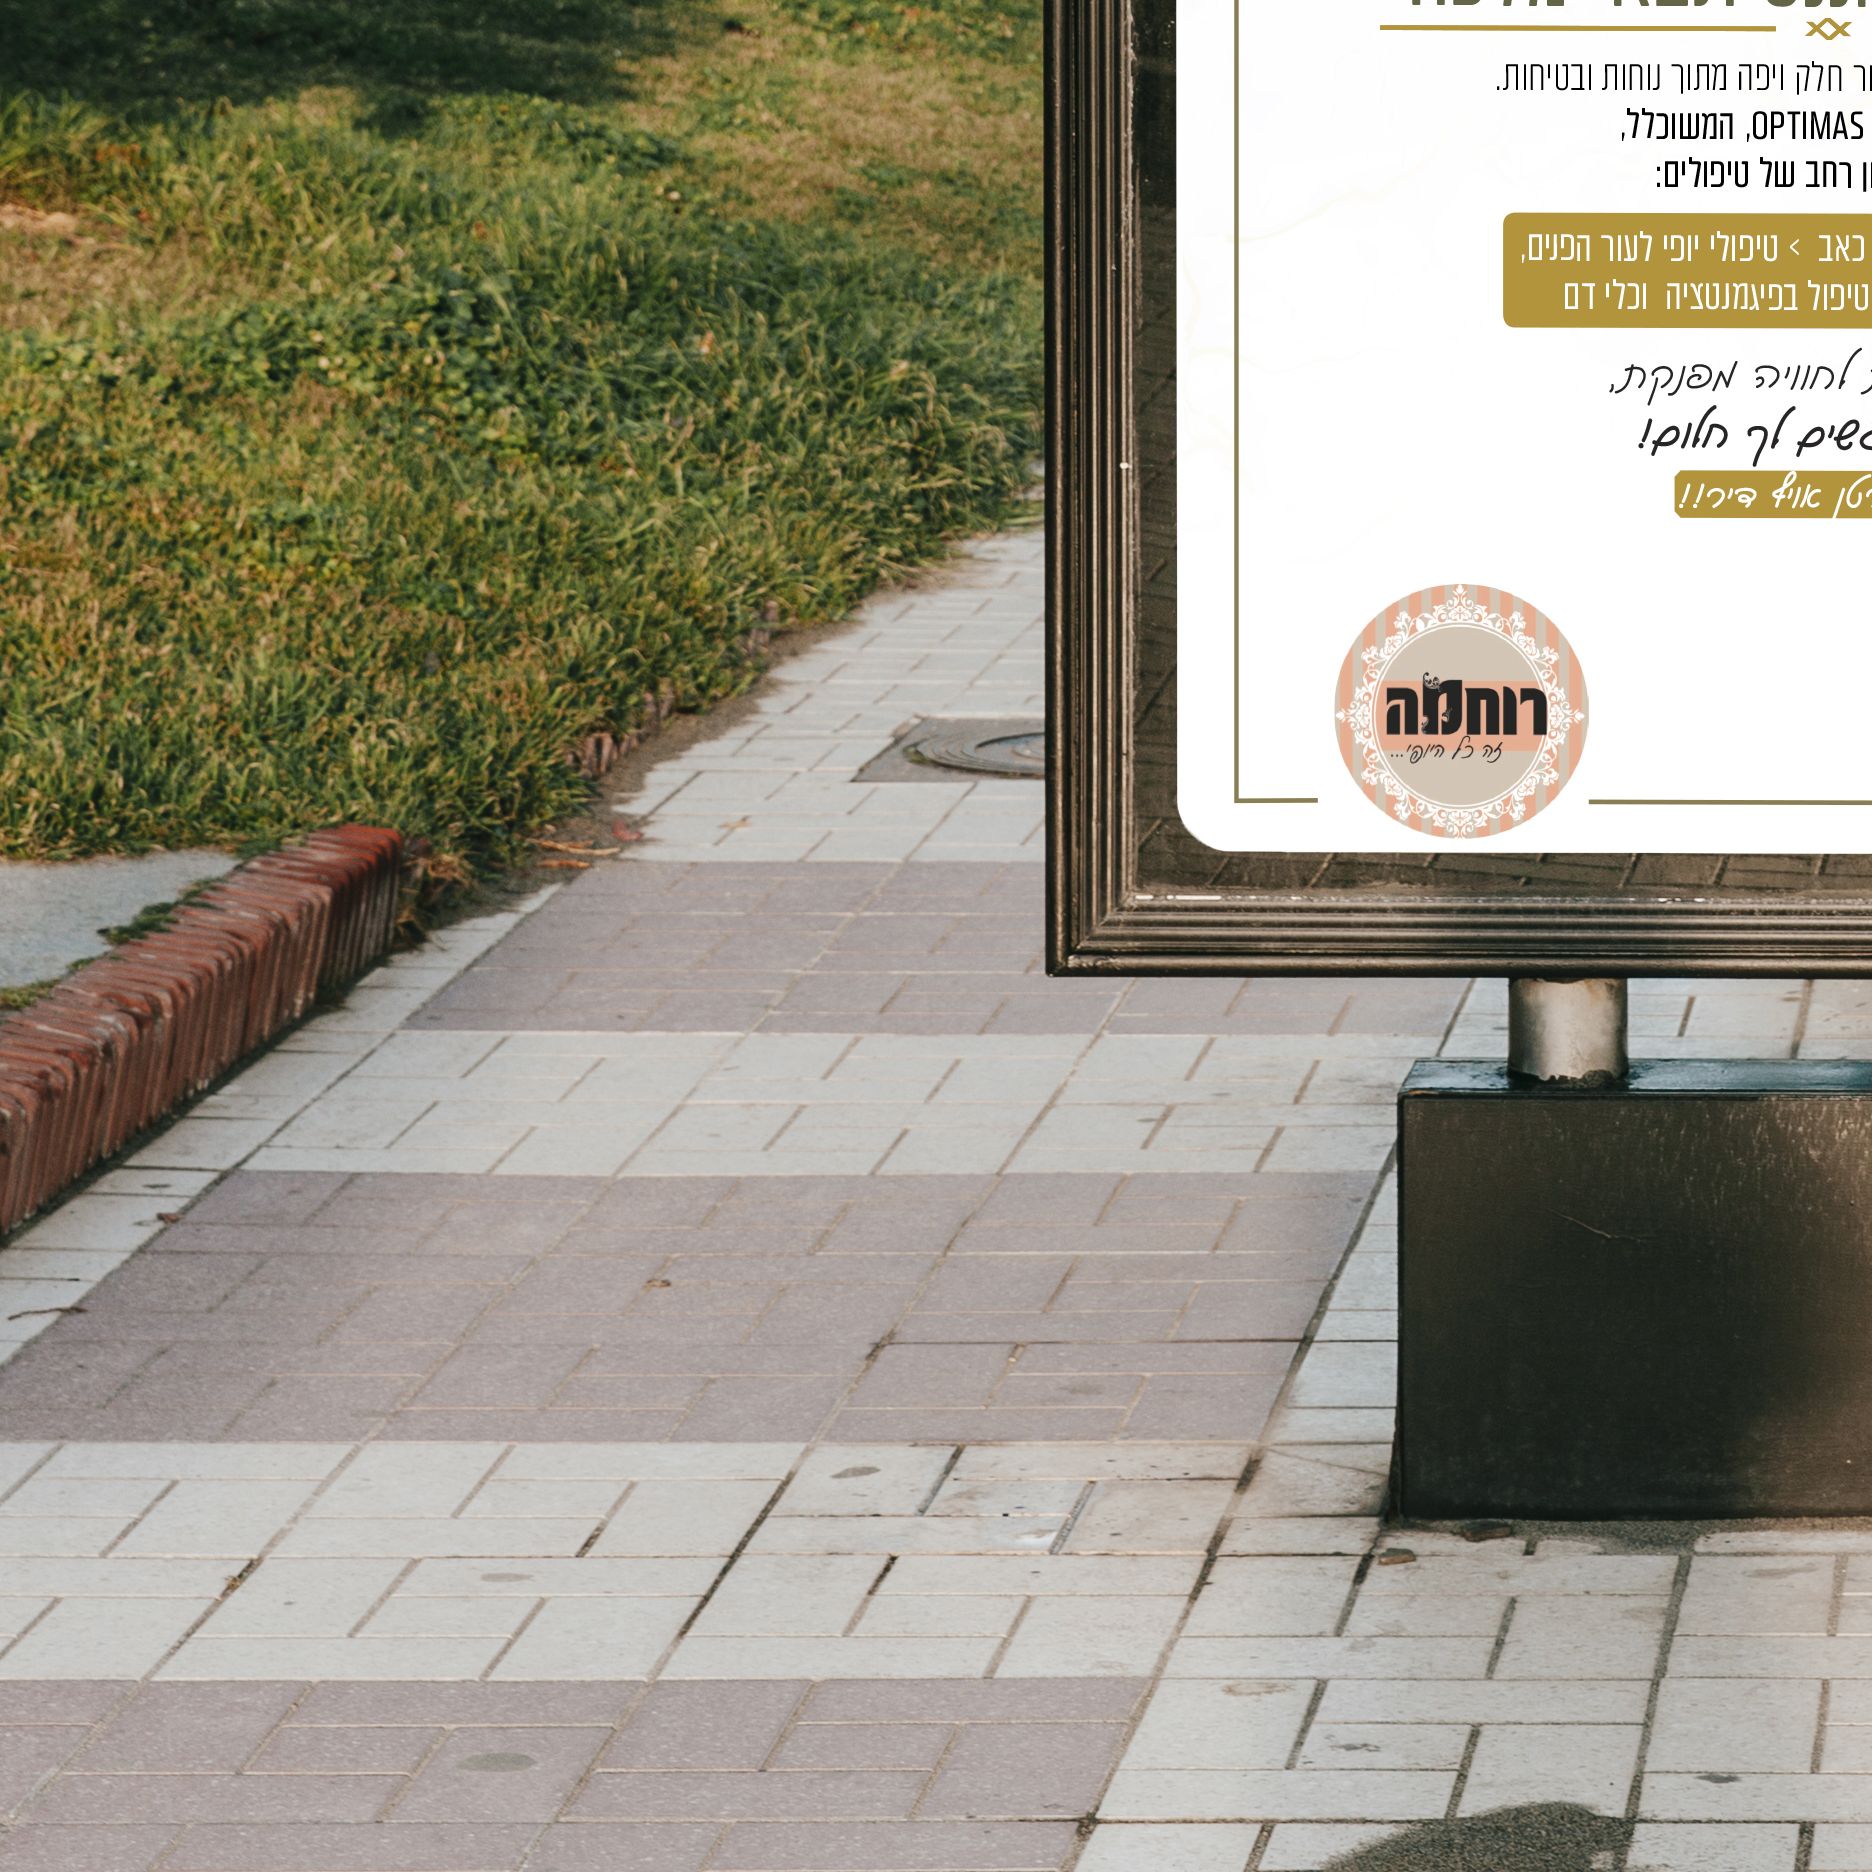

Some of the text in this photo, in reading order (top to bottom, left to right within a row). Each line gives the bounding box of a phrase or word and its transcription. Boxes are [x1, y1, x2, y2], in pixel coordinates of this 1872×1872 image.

[1496, 63, 1592, 91] ובטיחות.
[1601, 63, 1661, 91] נוחות
[1671, 63, 1727, 95] מתוך
[1738, 63, 1784, 91] ויפה
[1796, 60, 1842, 96] חלק
[1621, 107, 1734, 142] המשוכלל,
[1746, 110, 1864, 143] OPTIMAS,
[1656, 156, 1749, 188] טיפולים:
[1759, 156, 1795, 188] של
[1805, 160, 1852, 189] רחב
[1521, 233, 1590, 264] הפנים,
[1600, 230, 1653, 262] לעור
[1663, 234, 1699, 262] יופי
[1710, 230, 1778, 262] טיפולי
[1818, 234, 1865, 262] כאב
[1564, 282, 1596, 310] דם
[1605, 278, 1647, 310] וכלי
[1666, 282, 1798, 311] בפיגמנטציה
[1608, 360, 1738, 406] מפנקת,
[1754, 347, 1863, 392] לחוויה
[1637, 405, 1730, 457] חלום!
[1747, 405, 1797, 467] לך
[1386, 672, 1548, 736] רוחמה
